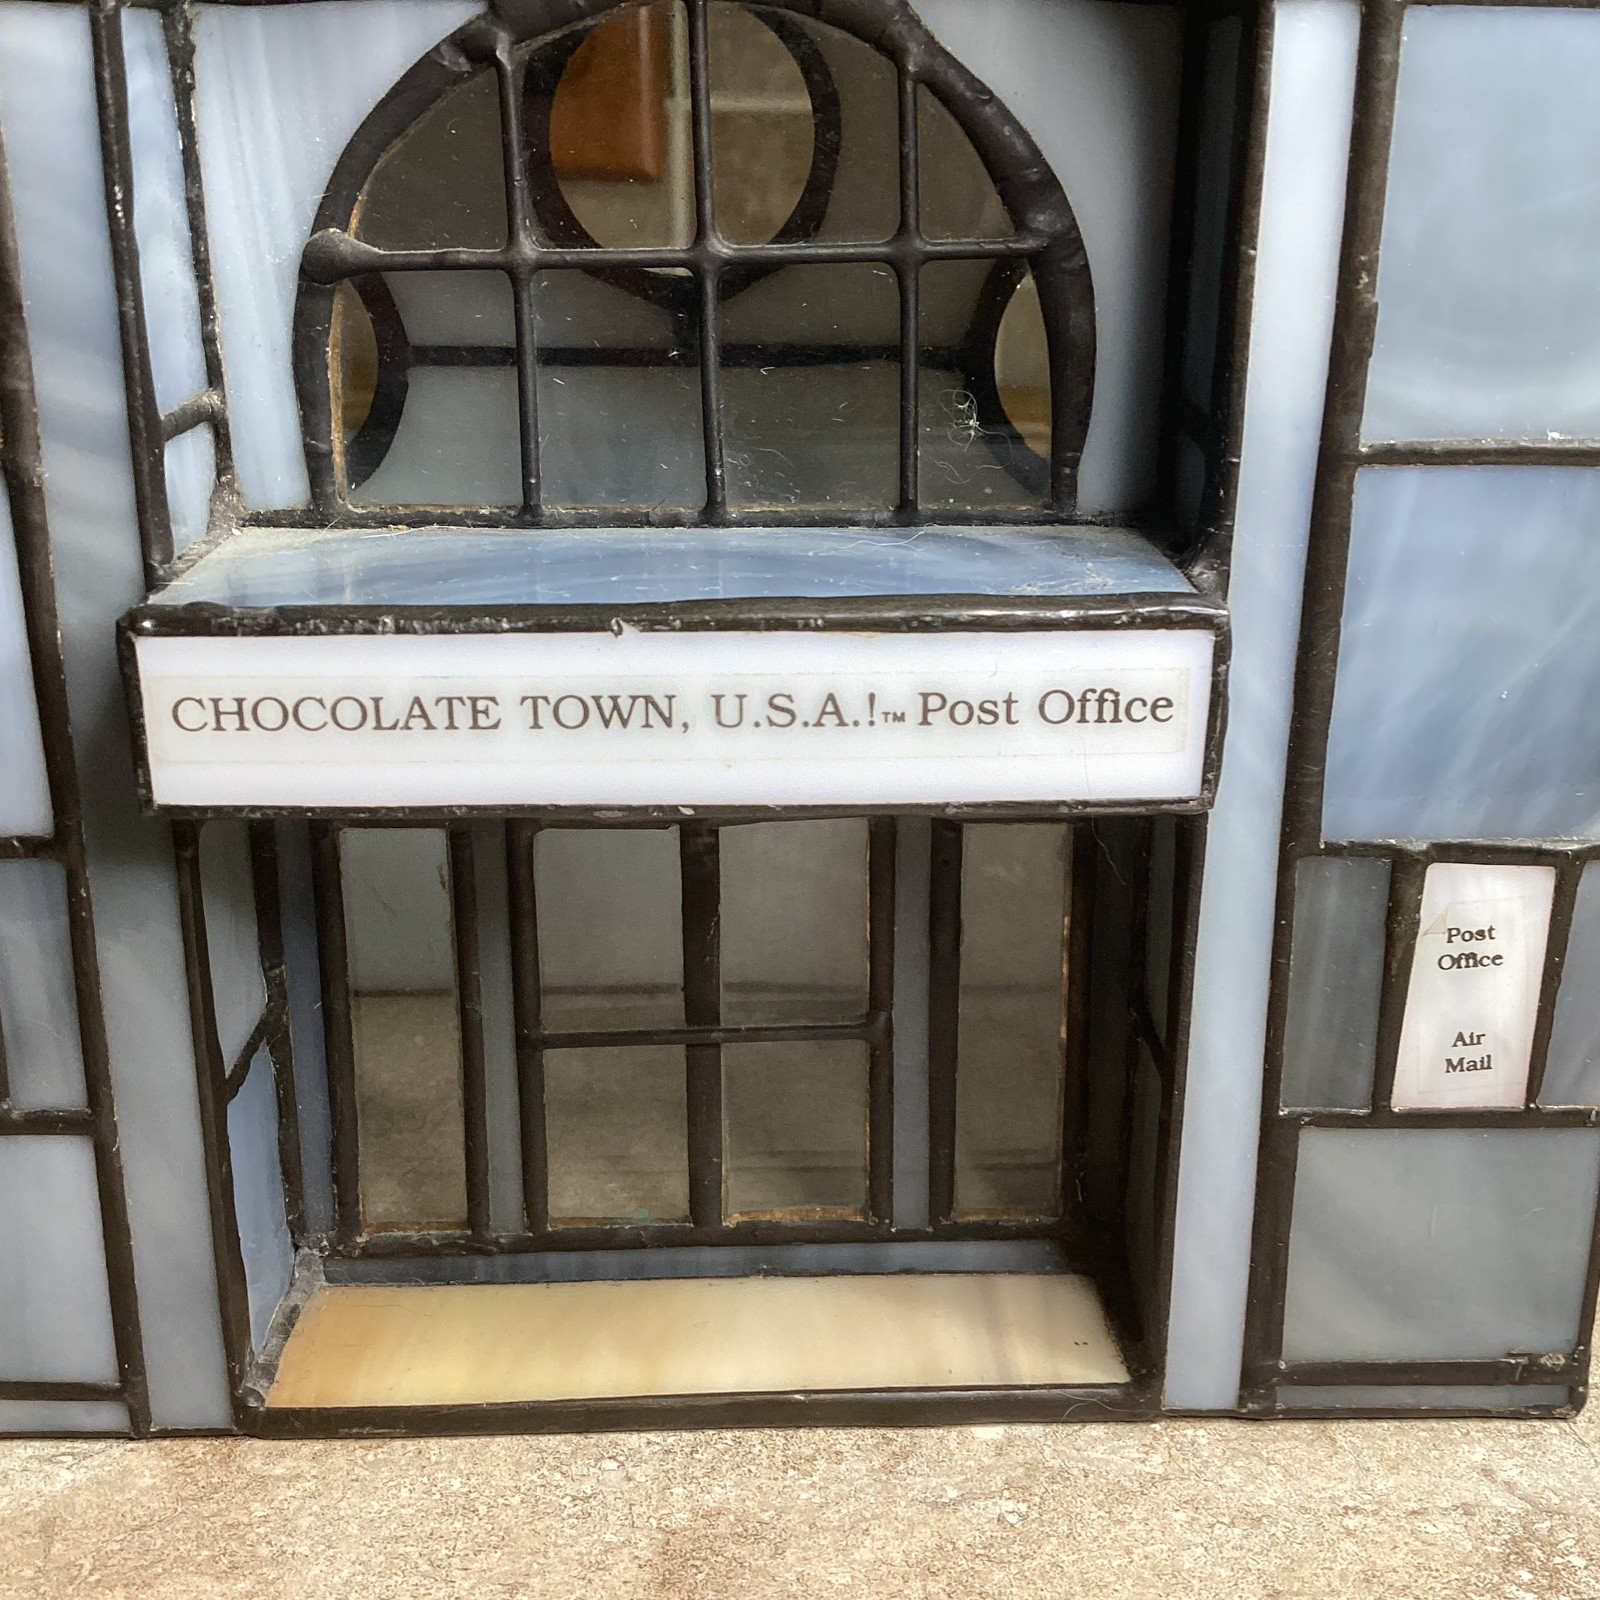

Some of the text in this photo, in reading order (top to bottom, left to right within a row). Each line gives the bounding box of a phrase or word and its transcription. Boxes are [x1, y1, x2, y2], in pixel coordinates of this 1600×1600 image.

[171, 695, 502, 733] CHOCOLATE
[519, 693, 690, 734] TOWN,
[917, 690, 1020, 727] Post
[1037, 687, 1174, 725] Office
[1446, 925, 1496, 943] Post
[1437, 951, 1504, 971] Office
[1450, 1031, 1487, 1048] Air
[1444, 1054, 1493, 1074] Mail
